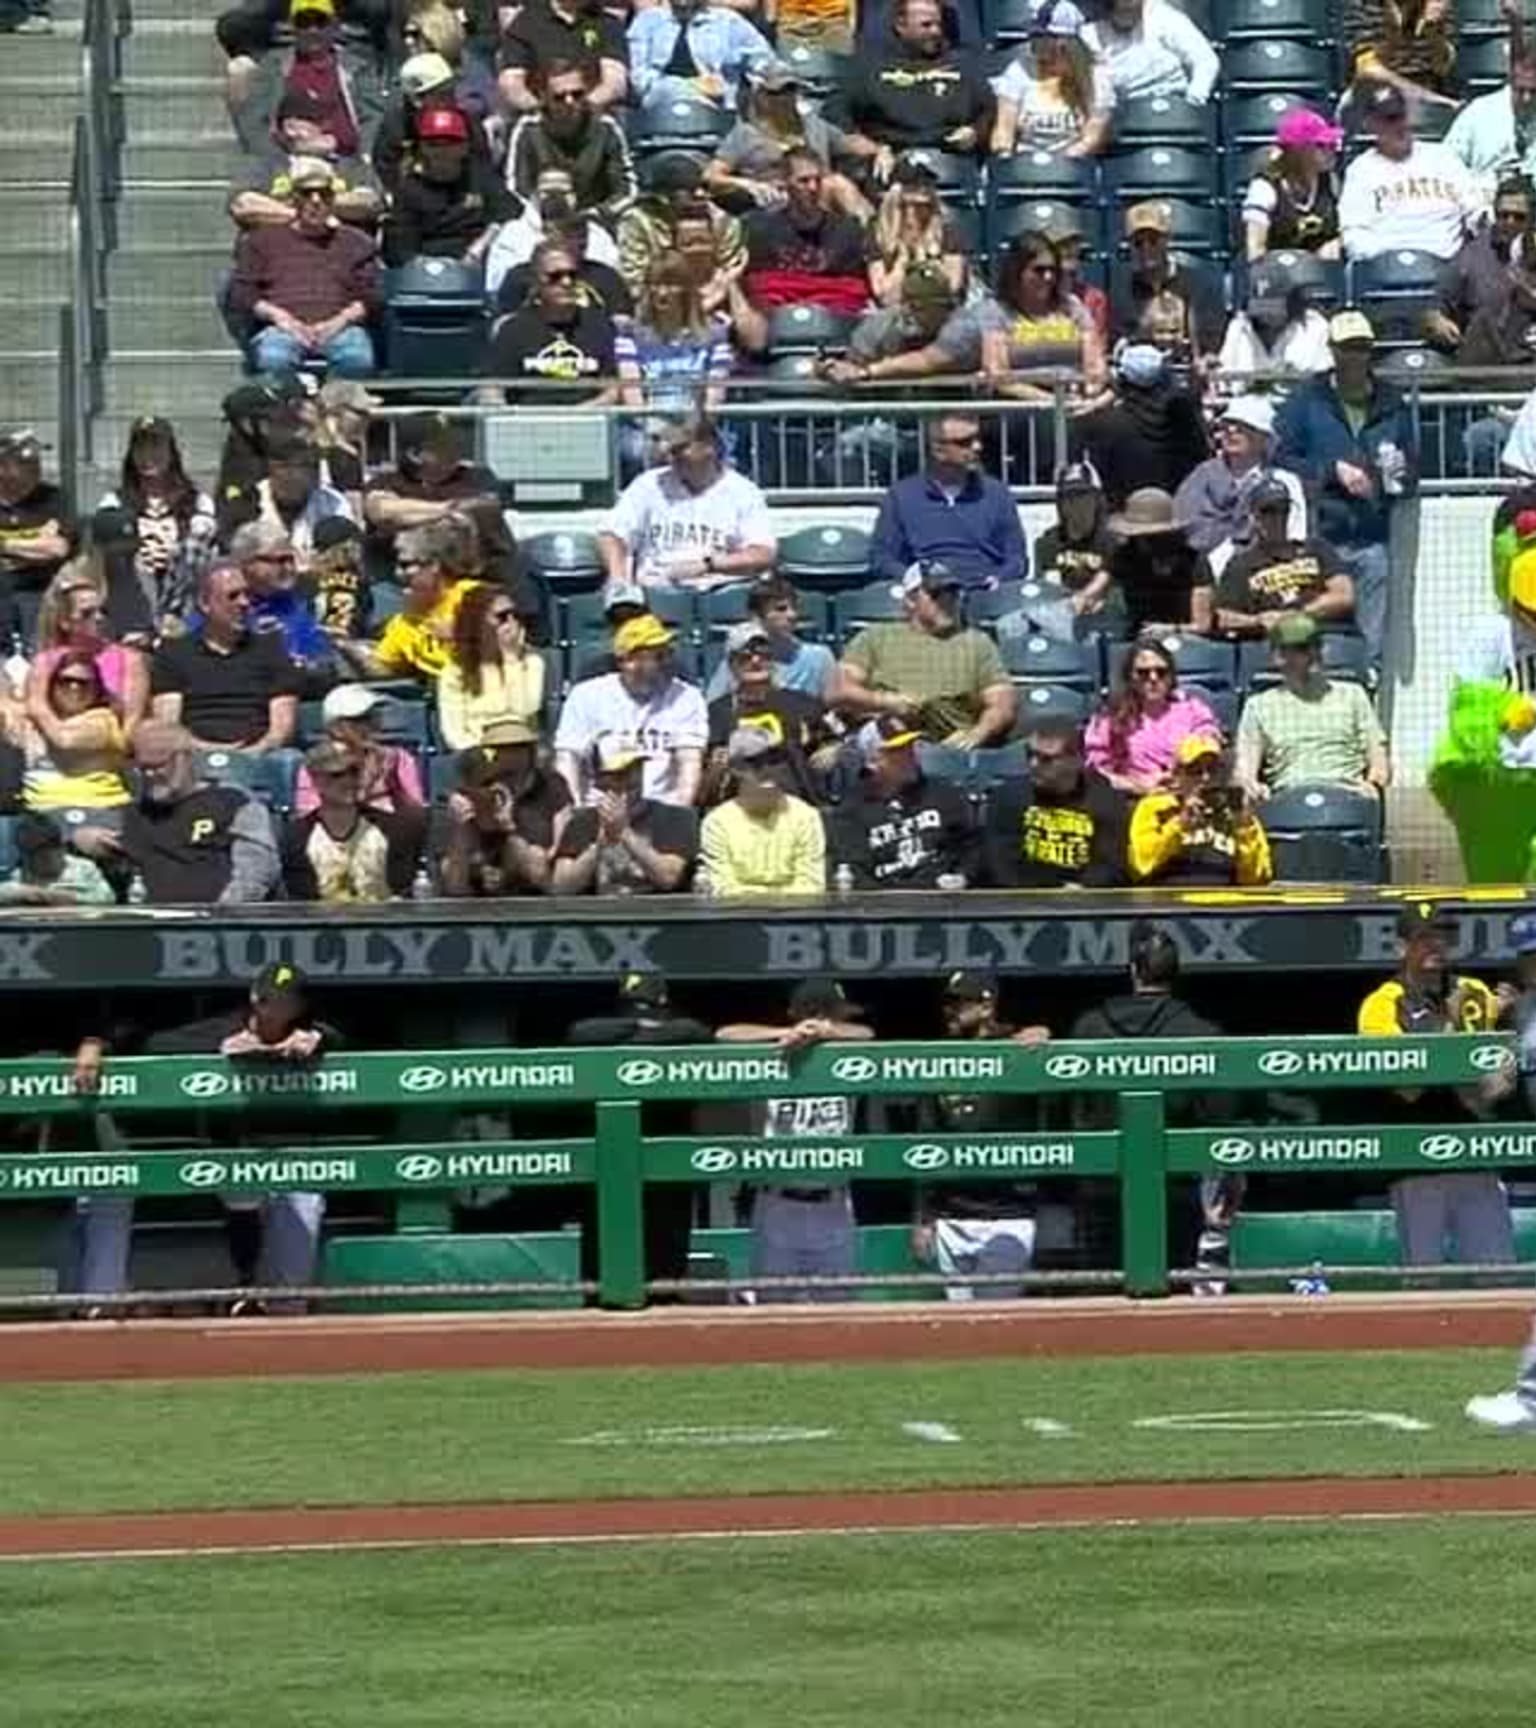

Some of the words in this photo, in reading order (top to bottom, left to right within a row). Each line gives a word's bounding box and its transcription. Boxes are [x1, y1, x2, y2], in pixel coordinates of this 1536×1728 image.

[649, 522, 732, 551] PIRATE
[155, 926, 440, 979] BULLY
[463, 924, 660, 973] MAX
[764, 920, 1048, 971] BULLY
[883, 1057, 1002, 1079] HYUNDAI
[1096, 1054, 1215, 1076] HYUNDAI
[1308, 1049, 1428, 1072] HYUNDAI
[11, 1075, 137, 1096] HYUAI
[452, 1064, 575, 1087] HYUNDAI
[741, 1148, 864, 1169] HYUNDAI
[953, 1144, 1075, 1166] HYUNDAI
[1261, 1138, 1380, 1159] HYUNDAI
[13, 1165, 139, 1188] HYUNDAI
[233, 1160, 356, 1183] HYUNDAI
[448, 1153, 571, 1177] HYUNDAI
